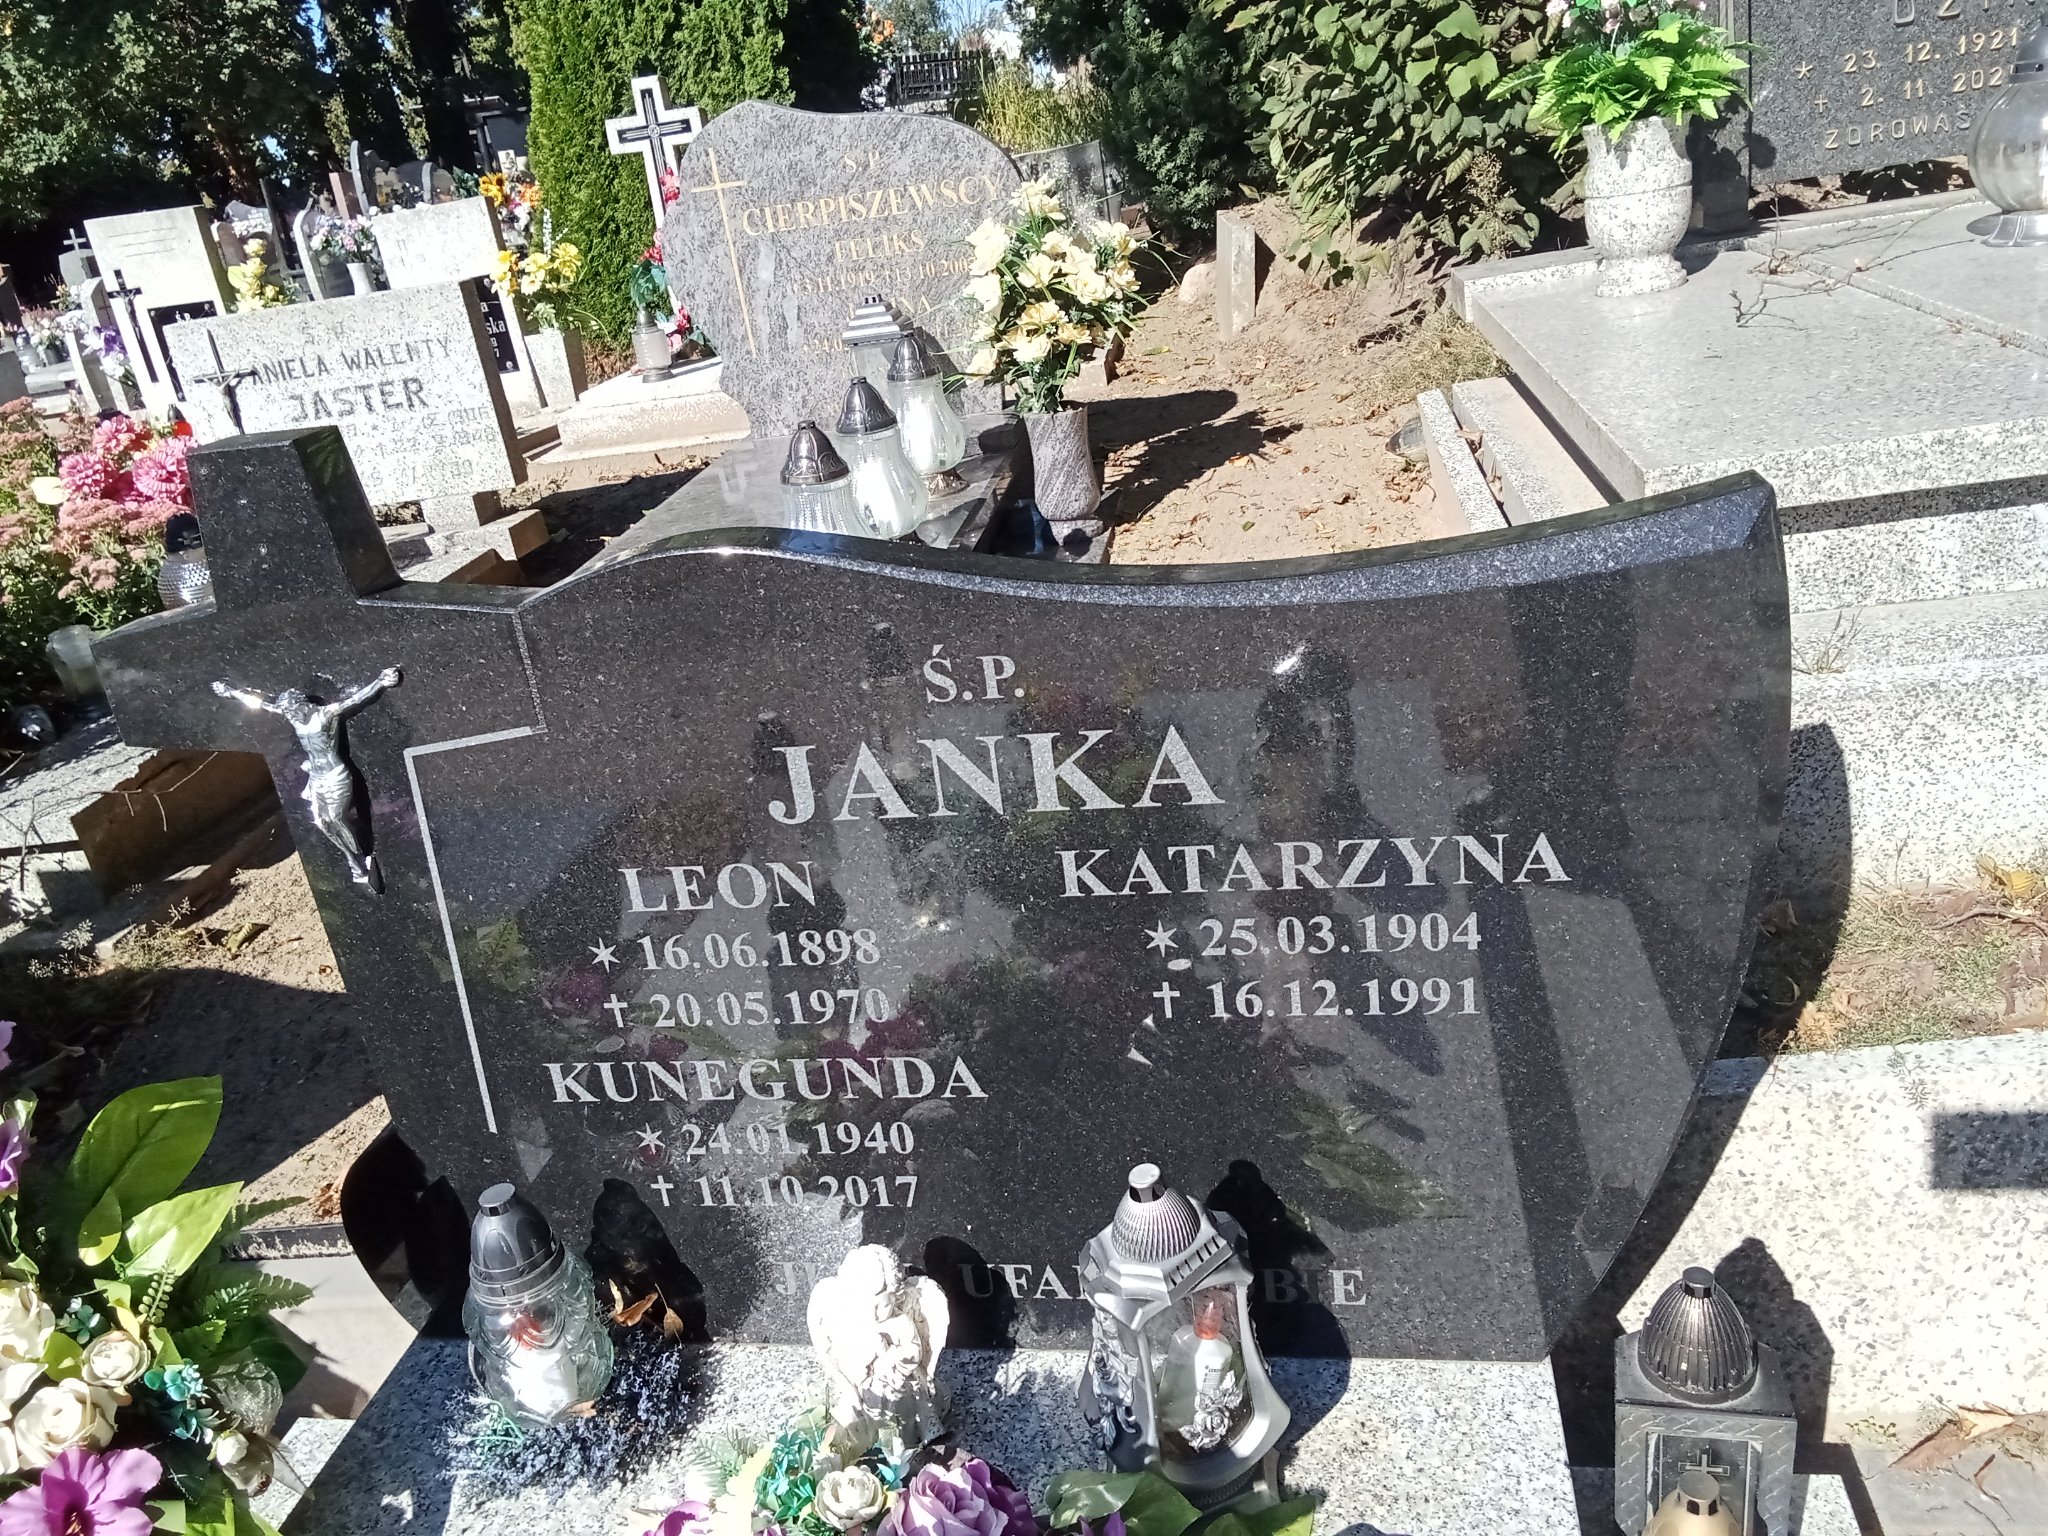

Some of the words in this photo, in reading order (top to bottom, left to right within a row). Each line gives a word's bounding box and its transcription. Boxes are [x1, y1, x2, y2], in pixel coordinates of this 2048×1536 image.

[1903, 41, 1941, 65] 12.
[1957, 27, 2018, 56] 1921
[742, 173, 1005, 236] CIERPISZEWSCY
[834, 229, 926, 263] FELIKS
[289, 376, 429, 423] JASTER
[922, 644, 1025, 703] Ś.P.
[768, 724, 1226, 826] JANKA
[618, 860, 816, 913] LEON
[1054, 831, 1573, 898] KATARZYNA
[637, 928, 882, 971] 16.06.1898
[1199, 911, 1483, 957] 25.03.1904
[650, 987, 891, 1028] 20.05.1970
[1206, 976, 1482, 1019] 16.12.1991
[543, 1054, 989, 1104] KUNEGUNDA
[681, 1120, 916, 1159] 24.01.1940
[700, 1174, 918, 1209] 11.10.2017
